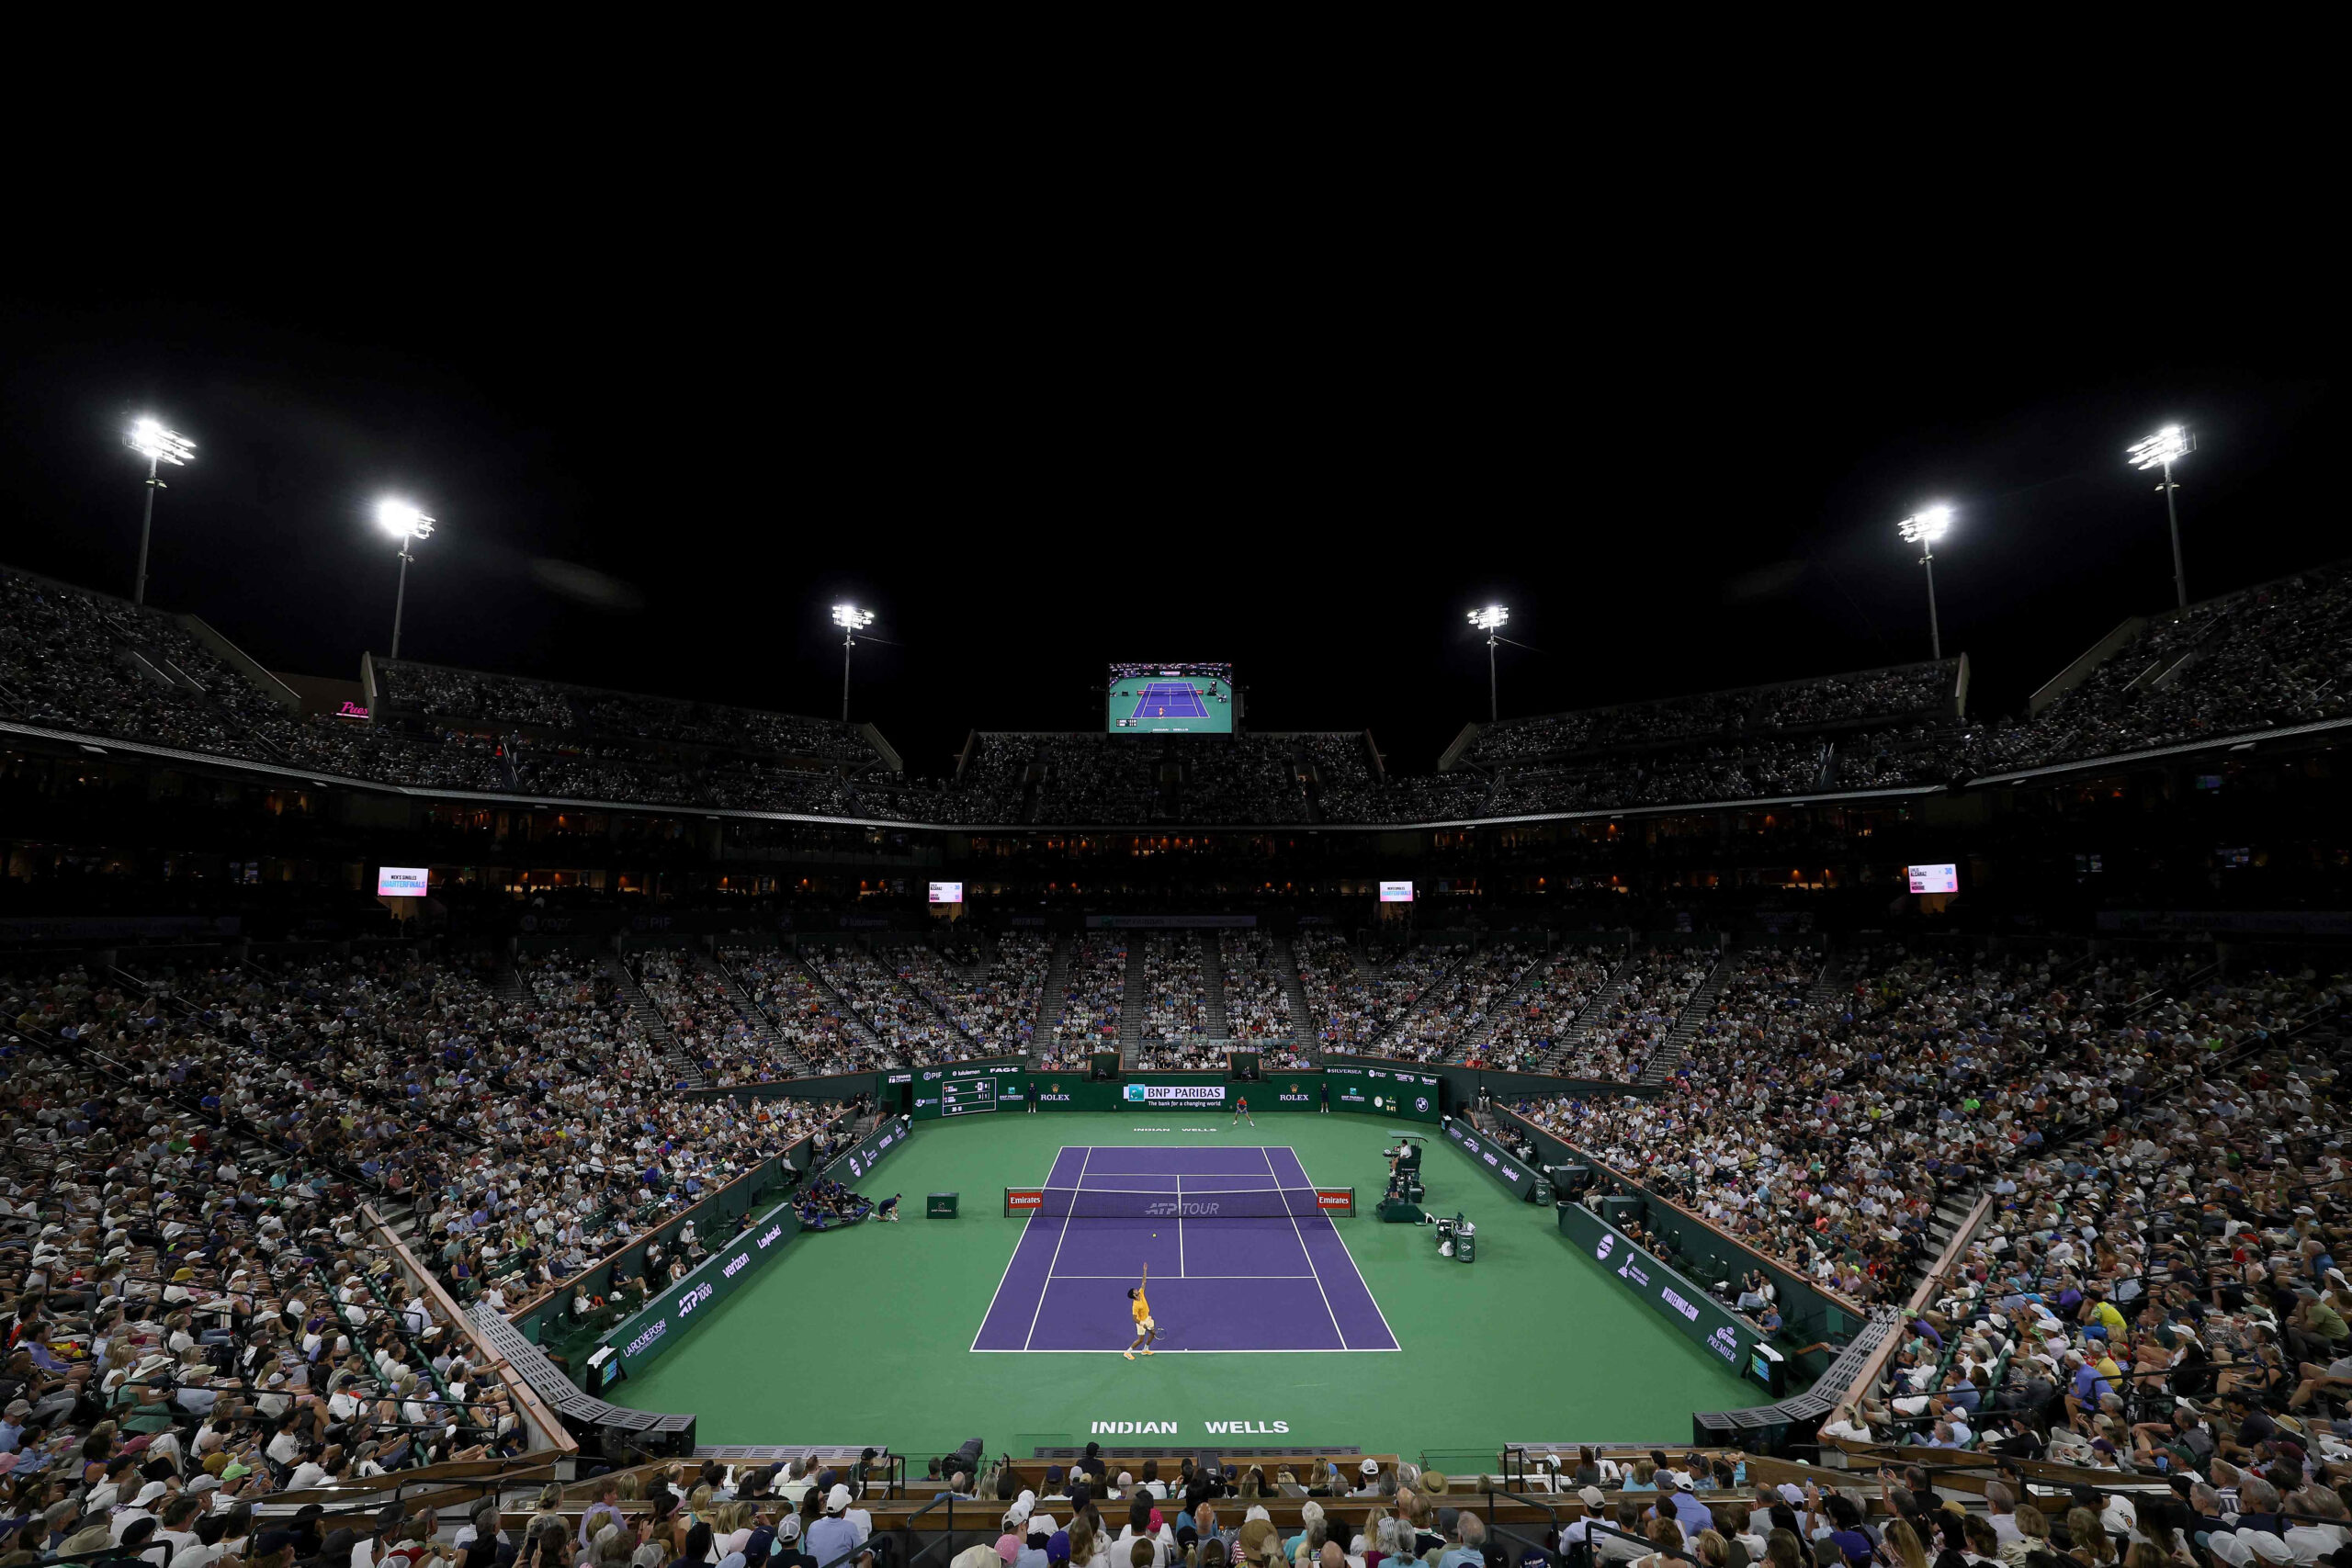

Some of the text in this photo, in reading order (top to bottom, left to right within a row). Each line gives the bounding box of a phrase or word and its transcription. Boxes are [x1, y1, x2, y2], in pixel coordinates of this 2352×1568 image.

[932, 1071, 943, 1079] PIF
[1148, 1088, 1221, 1098] BNP PARIBAS
[1011, 1196, 1041, 1204] Emirates
[1318, 1196, 1349, 1204] Emirates
[1145, 1202, 1220, 1215] ATP TOUR
[756, 1224, 782, 1249] Laykold
[722, 1252, 750, 1278] verizon
[678, 1283, 713, 1317] ATP 1000
[1716, 1327, 1737, 1348] Corona
[1706, 1335, 1736, 1363] PREMIER
[1091, 1421, 1290, 1434] INDIAN WELLS
